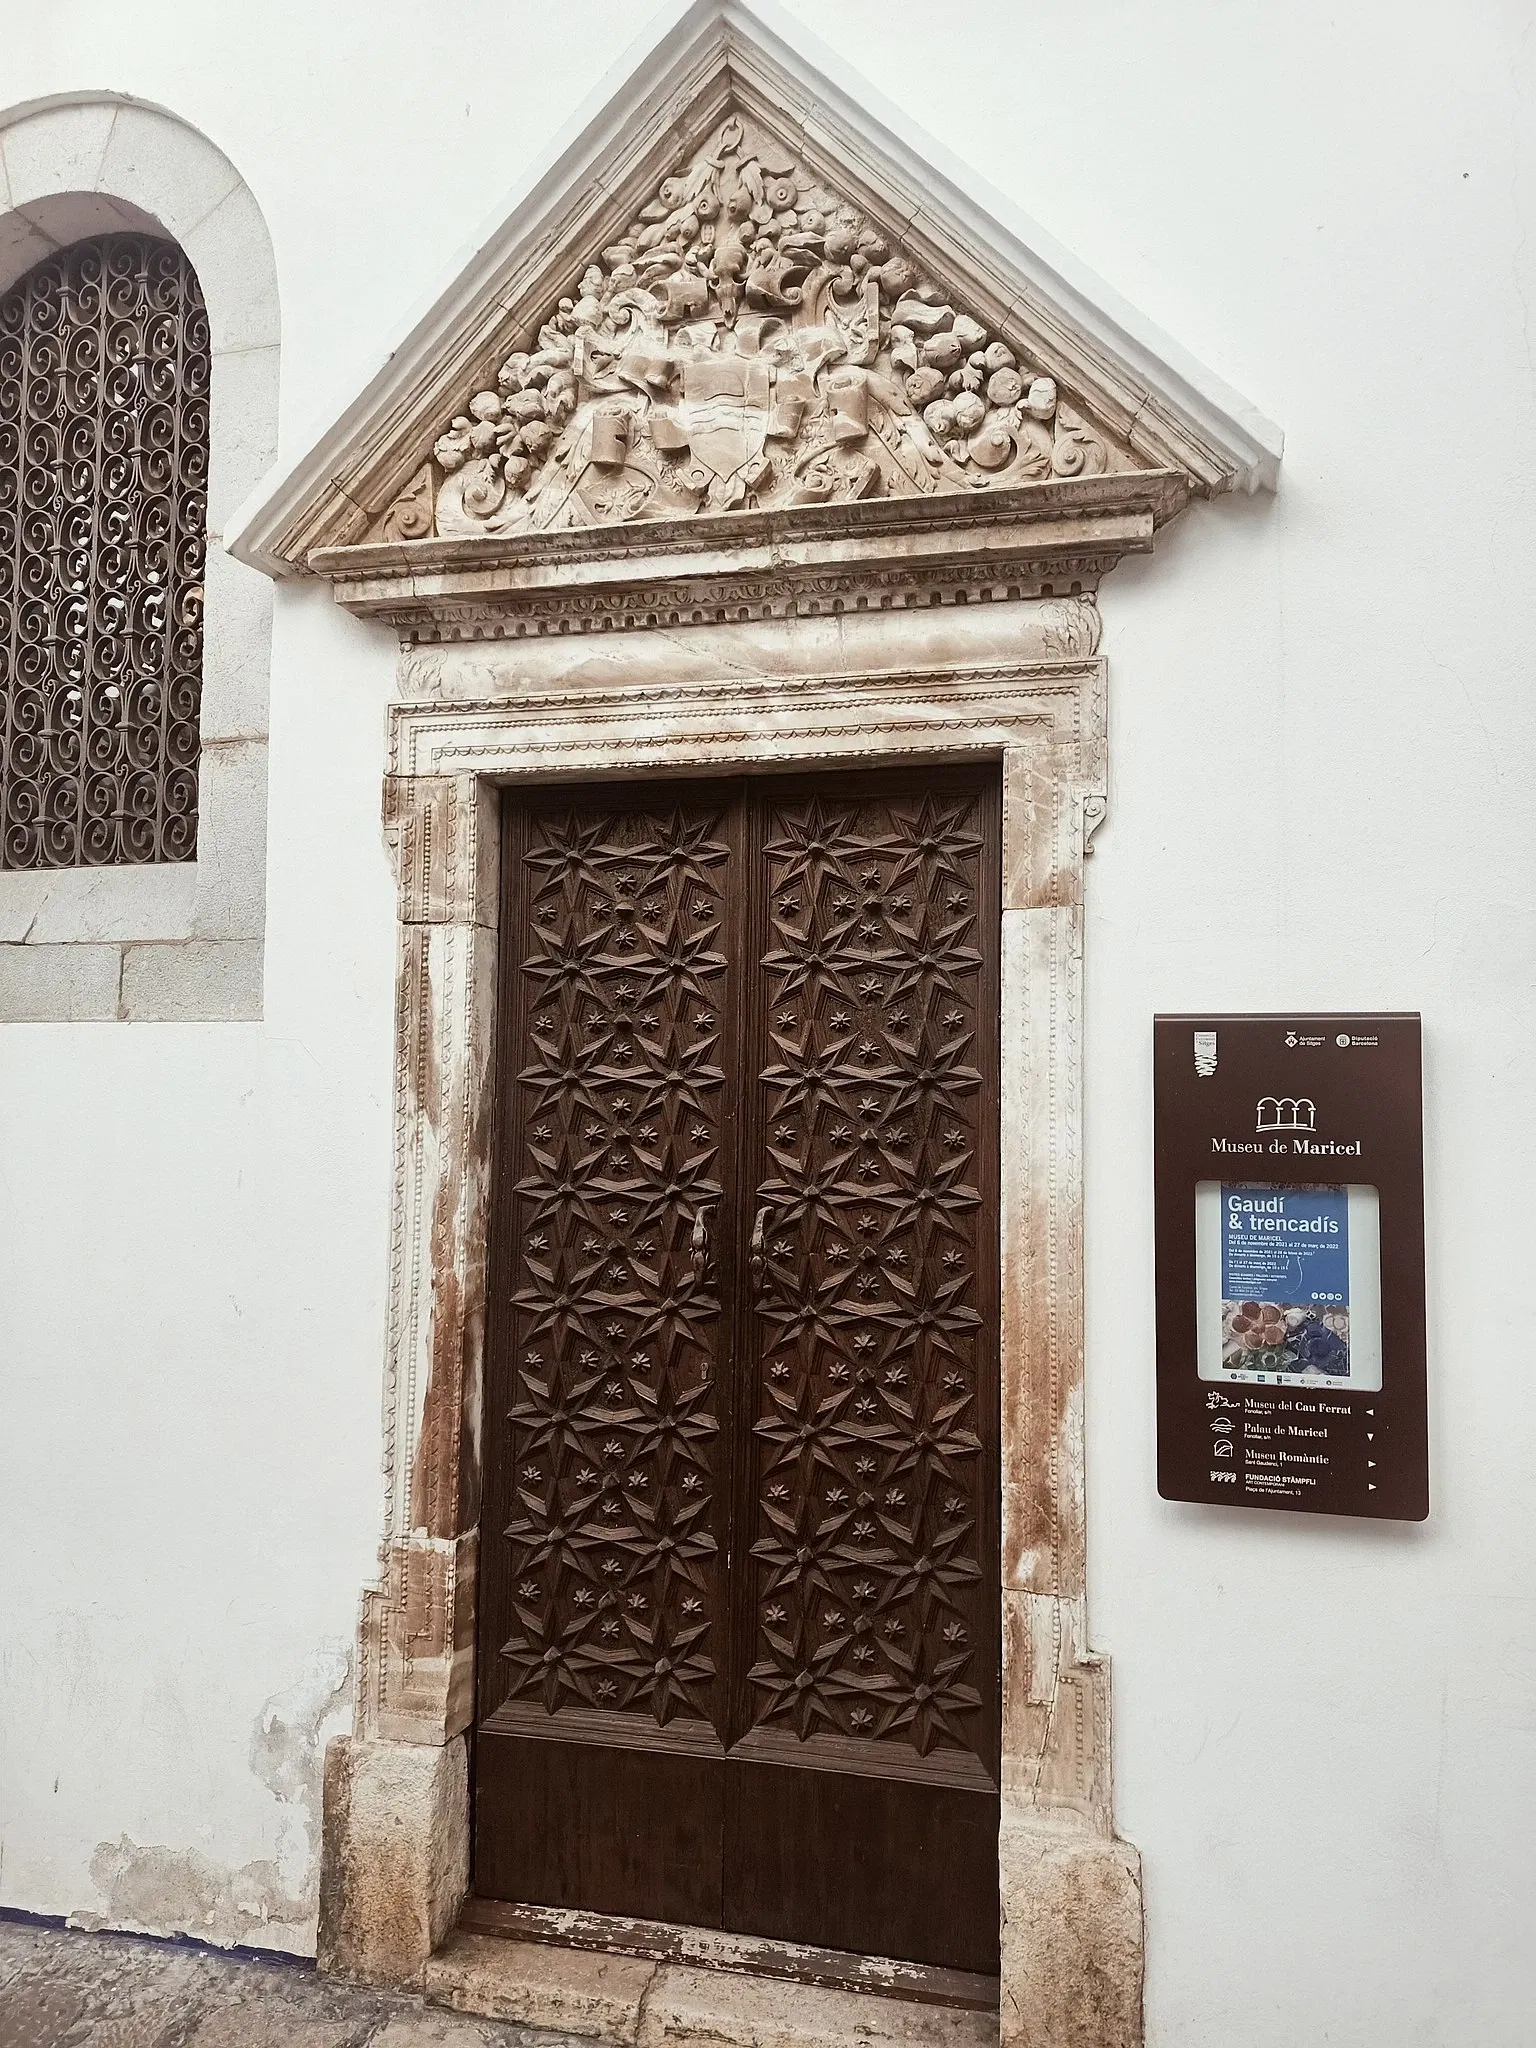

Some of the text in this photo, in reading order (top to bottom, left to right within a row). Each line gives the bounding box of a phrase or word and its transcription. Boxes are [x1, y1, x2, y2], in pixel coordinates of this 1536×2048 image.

[1211, 1138, 1362, 1156] Museu de Maricel
[1228, 1196, 1285, 1214] Gaudí
[1228, 1213, 1338, 1233] & trencadís
[1244, 1398, 1351, 1414] Museu del Cau Ferrat
[1244, 1422, 1328, 1437] Palau de Maricel
[1245, 1449, 1329, 1464] Museu Romàntic
[1245, 1474, 1280, 1482] FUNDACIÓ
